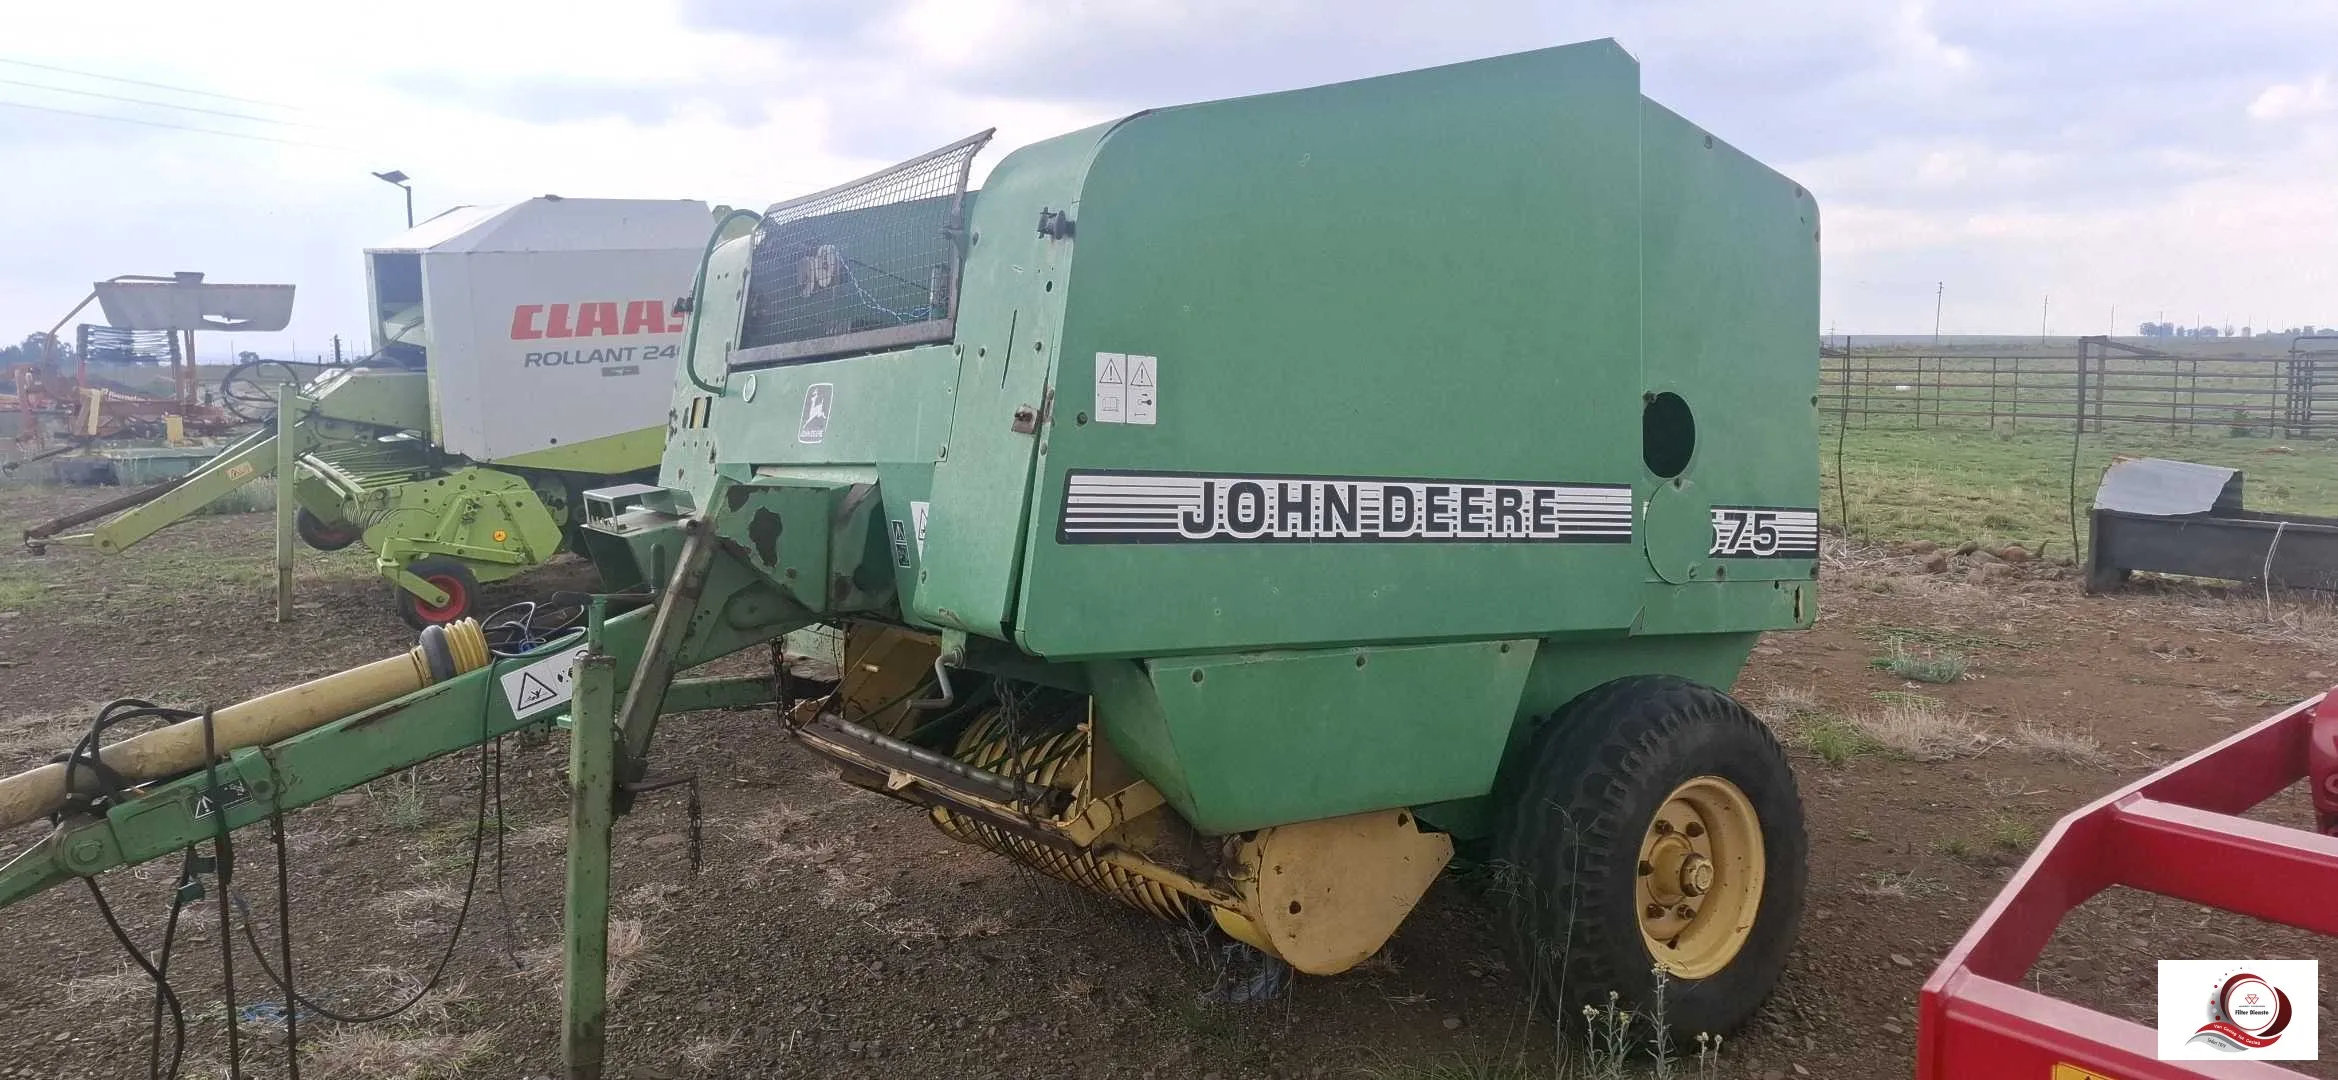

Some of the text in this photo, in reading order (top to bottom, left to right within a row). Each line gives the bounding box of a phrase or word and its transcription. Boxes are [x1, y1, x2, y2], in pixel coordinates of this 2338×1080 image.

[524, 345, 680, 367] ROLLANT 24
[1178, 480, 1558, 538] JOHN DEERE
[1711, 511, 1779, 555] 75
